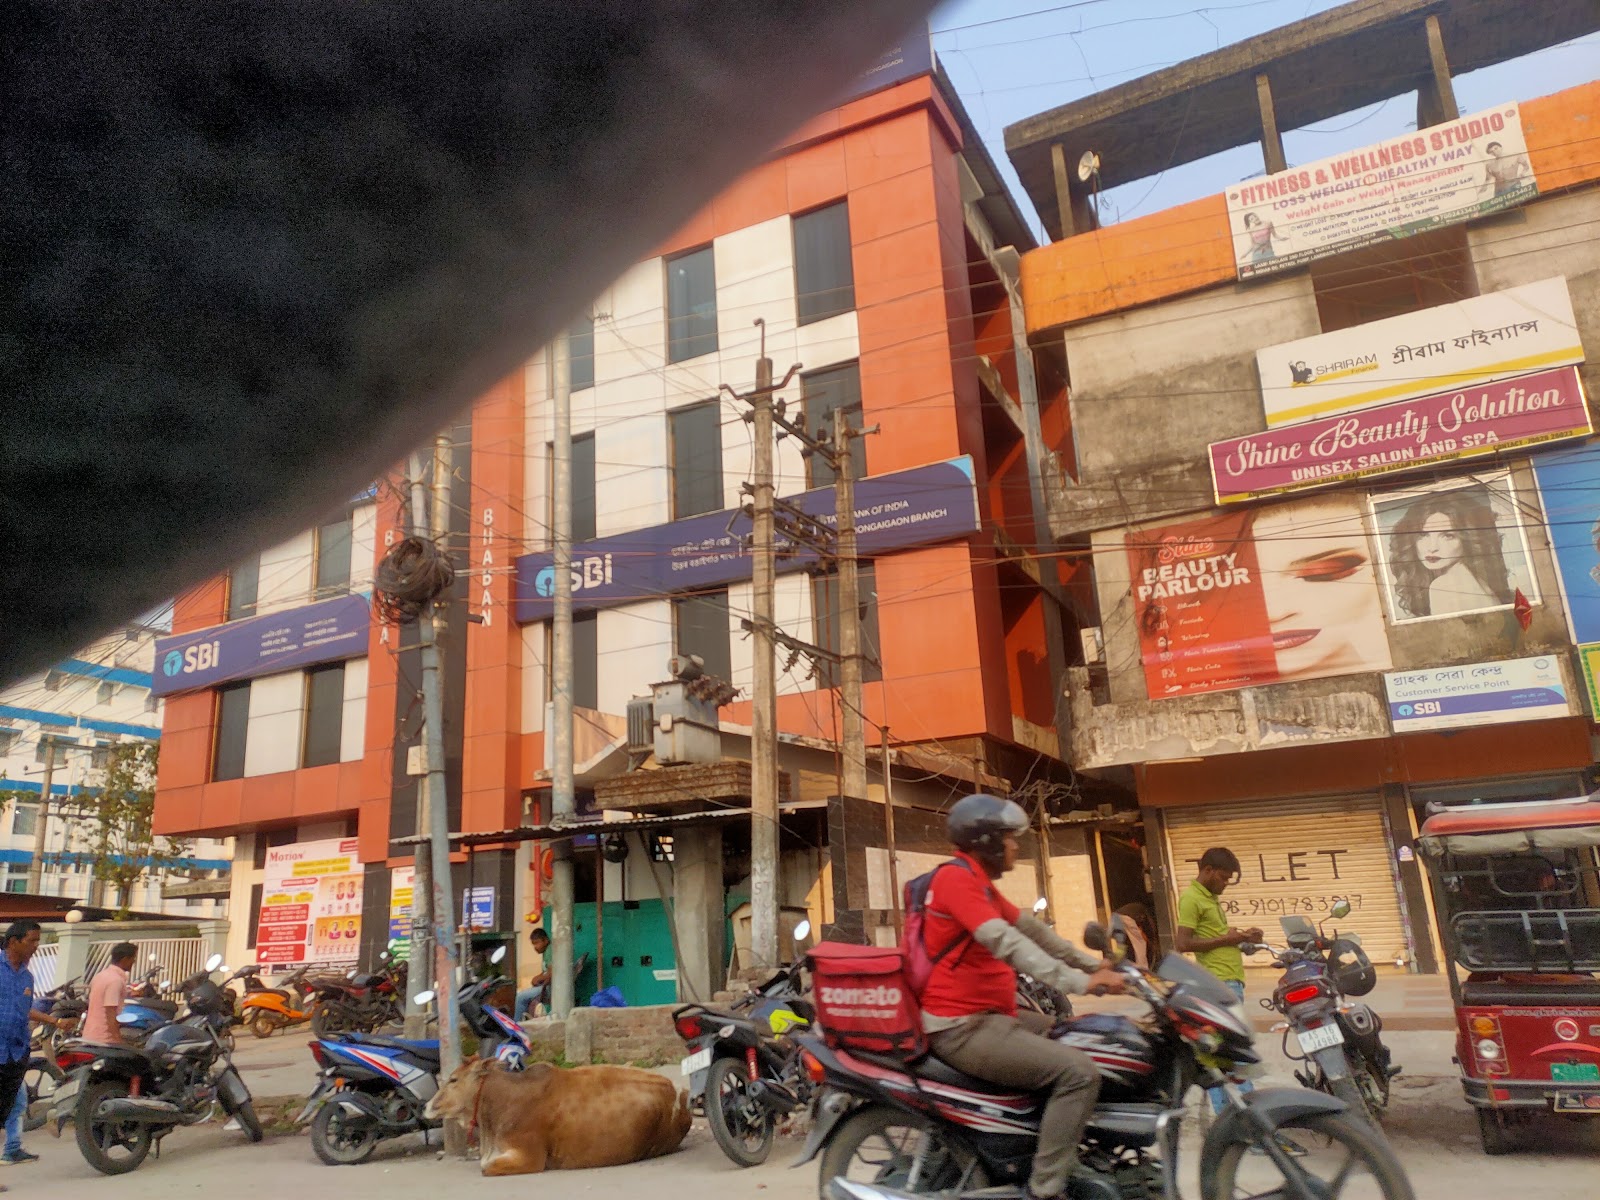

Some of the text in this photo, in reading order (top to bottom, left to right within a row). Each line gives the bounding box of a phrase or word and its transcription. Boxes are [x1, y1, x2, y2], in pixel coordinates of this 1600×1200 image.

[1240, 112, 1504, 206] FITNESS & WELLNESS STUDIO
[1378, 144, 1473, 181] HEALTHY WAY
[1273, 178, 1362, 211] LOSS WEIGHT
[1286, 204, 1321, 221] Weight
[1322, 197, 1345, 210] Gain
[1358, 184, 1394, 201] Weight
[1397, 164, 1465, 189] Management
[1316, 353, 1377, 376] SHRIRAM
[1225, 387, 1566, 476] Shine Beauty Solution
[1291, 430, 1500, 481] UNISEX SALON AND SPA
[854, 507, 871, 518] ANK
[883, 499, 909, 514] INDIA
[911, 508, 948, 523] BRANCH
[1158, 535, 1214, 563] Shine
[1137, 567, 1251, 602] PARLOUR
[1143, 552, 1238, 585] BEAUTY
[1395, 679, 1510, 698] Customer Service Point
[1413, 701, 1441, 715] SBI
[1258, 849, 1348, 883] LET
[820, 984, 903, 1006] zomato
[1308, 1025, 1335, 1041] AS 16
